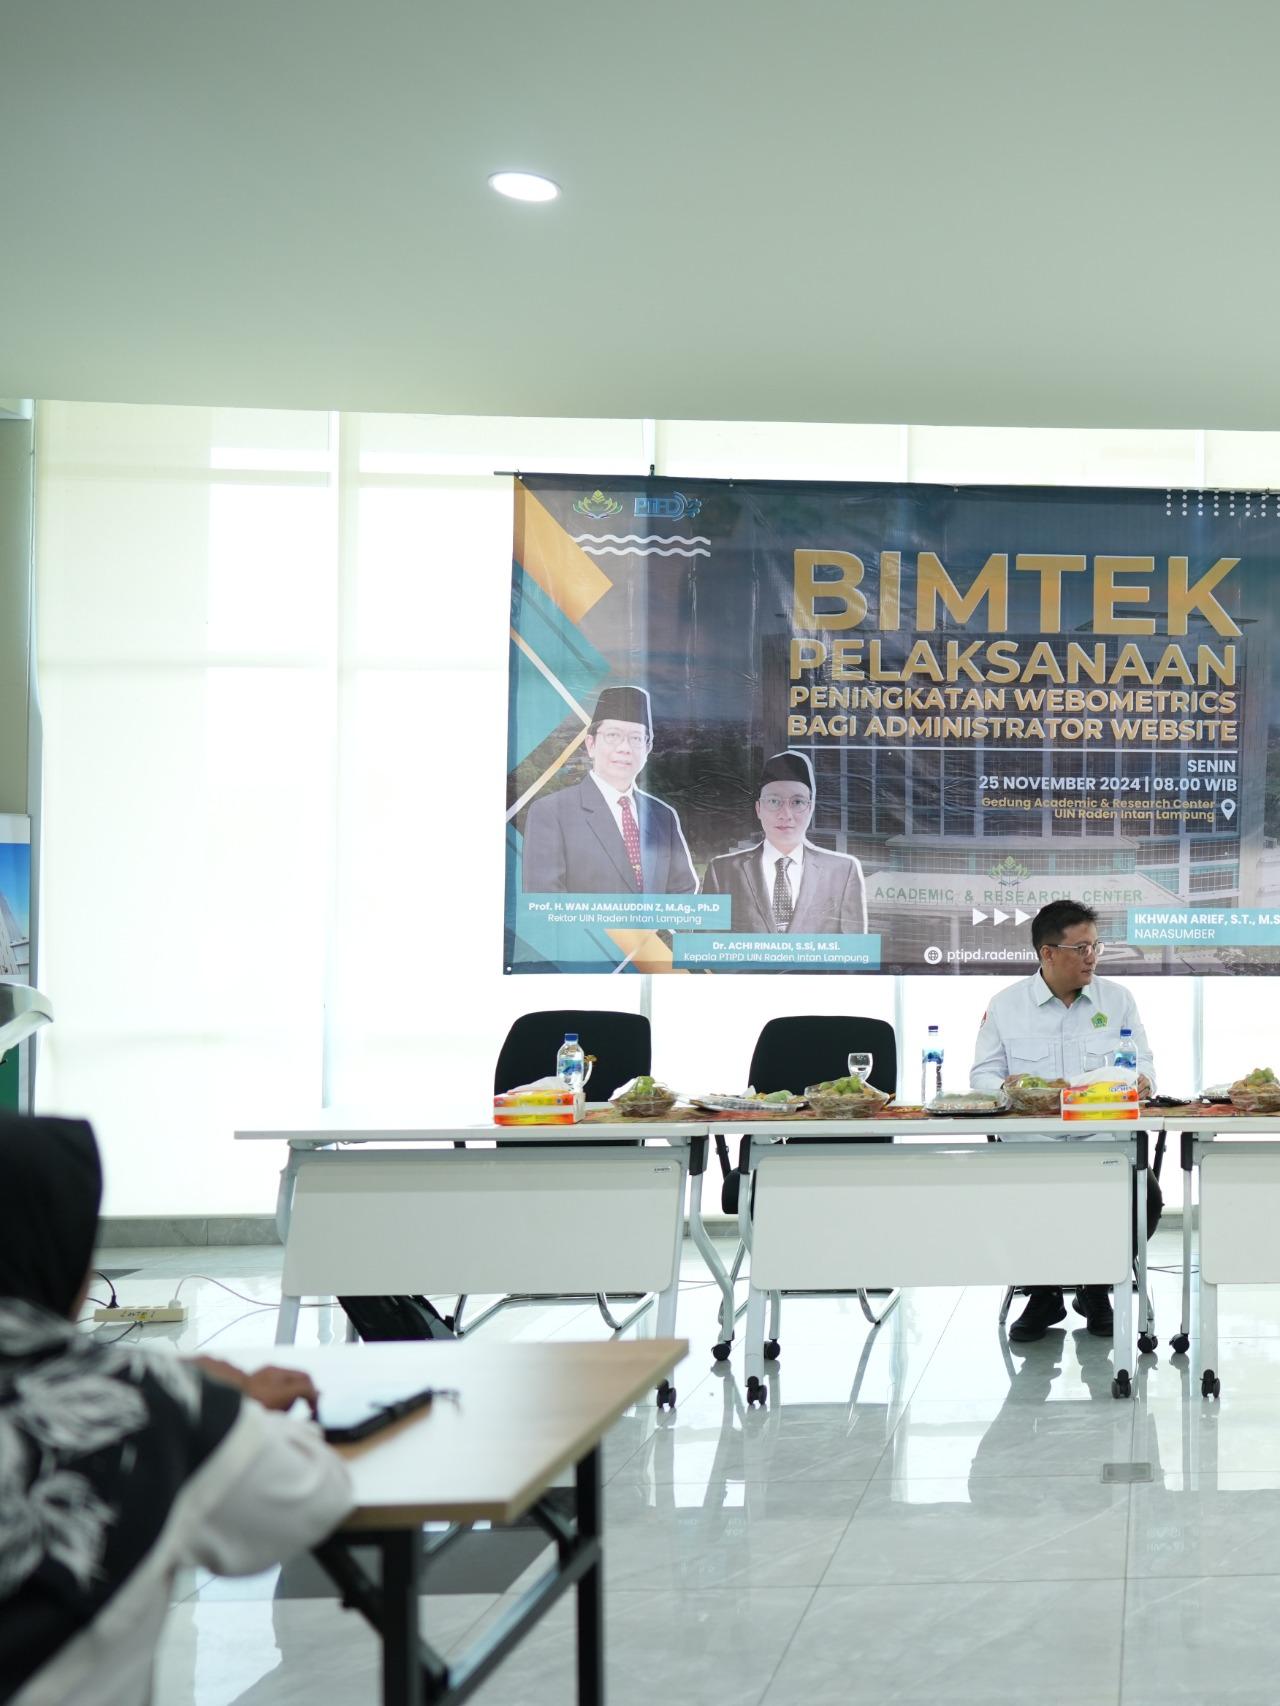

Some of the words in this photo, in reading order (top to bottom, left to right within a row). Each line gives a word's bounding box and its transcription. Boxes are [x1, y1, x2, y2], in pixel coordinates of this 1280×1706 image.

[793, 548, 1244, 637] BIMTEK
[789, 638, 1237, 686] PELAKSANAAN
[789, 686, 1006, 711] PENINGKATAN
[1014, 690, 1237, 714] WEBOMETRICS
[787, 715, 858, 738] BAGI
[864, 716, 1103, 740] ADMINISTRATOR
[1110, 719, 1238, 742] WEBSITE
[1187, 759, 1236, 773] SENIN
[979, 776, 999, 790] 25
[1003, 776, 1096, 791] NOVEMBER
[1100, 777, 1141, 791] 2024
[1153, 778, 1201, 791] 08.00
[1205, 778, 1238, 792] WIB
[981, 797, 1031, 811] Gedung
[1034, 797, 1098, 809] Academic
[1100, 798, 1109, 809] &
[1113, 798, 1169, 809] Research
[1173, 799, 1214, 809] Center
[1054, 810, 1075, 819] UIN
[1078, 809, 1118, 819] Raden
[1121, 810, 1152, 820] Intan
[1156, 811, 1215, 822] Lampung
[875, 887, 955, 901] ACADEMIC
[964, 889, 974, 901] &
[983, 890, 1071, 902] RESEARCH
[1082, 889, 1143, 903] CENTER
[528, 902, 552, 911] Prof.
[554, 903, 564, 911] H.
[566, 903, 589, 911] WAN
[591, 903, 653, 912] JAMALUDDIN
[698, 903, 720, 912] Ph.D
[548, 913, 577, 922] Rektor
[579, 913, 595, 922] UIN
[597, 914, 628, 923] Raden
[630, 914, 654, 923] Intan
[657, 914, 702, 925] Lampung
[1134, 914, 1187, 925] IKHWAN
[1190, 914, 1228, 926] ARIEF,
[1134, 928, 1216, 939] NARASUMBER
[712, 942, 726, 950] Dr.
[728, 942, 753, 950] ACHI
[754, 942, 793, 952] RINALDI,
[684, 953, 717, 963] Kepala
[719, 953, 744, 962] PTIPD
[747, 953, 762, 962] UIN
[764, 953, 794, 962] Raden
[797, 953, 822, 962] Intan
[824, 953, 869, 964] Lampung
